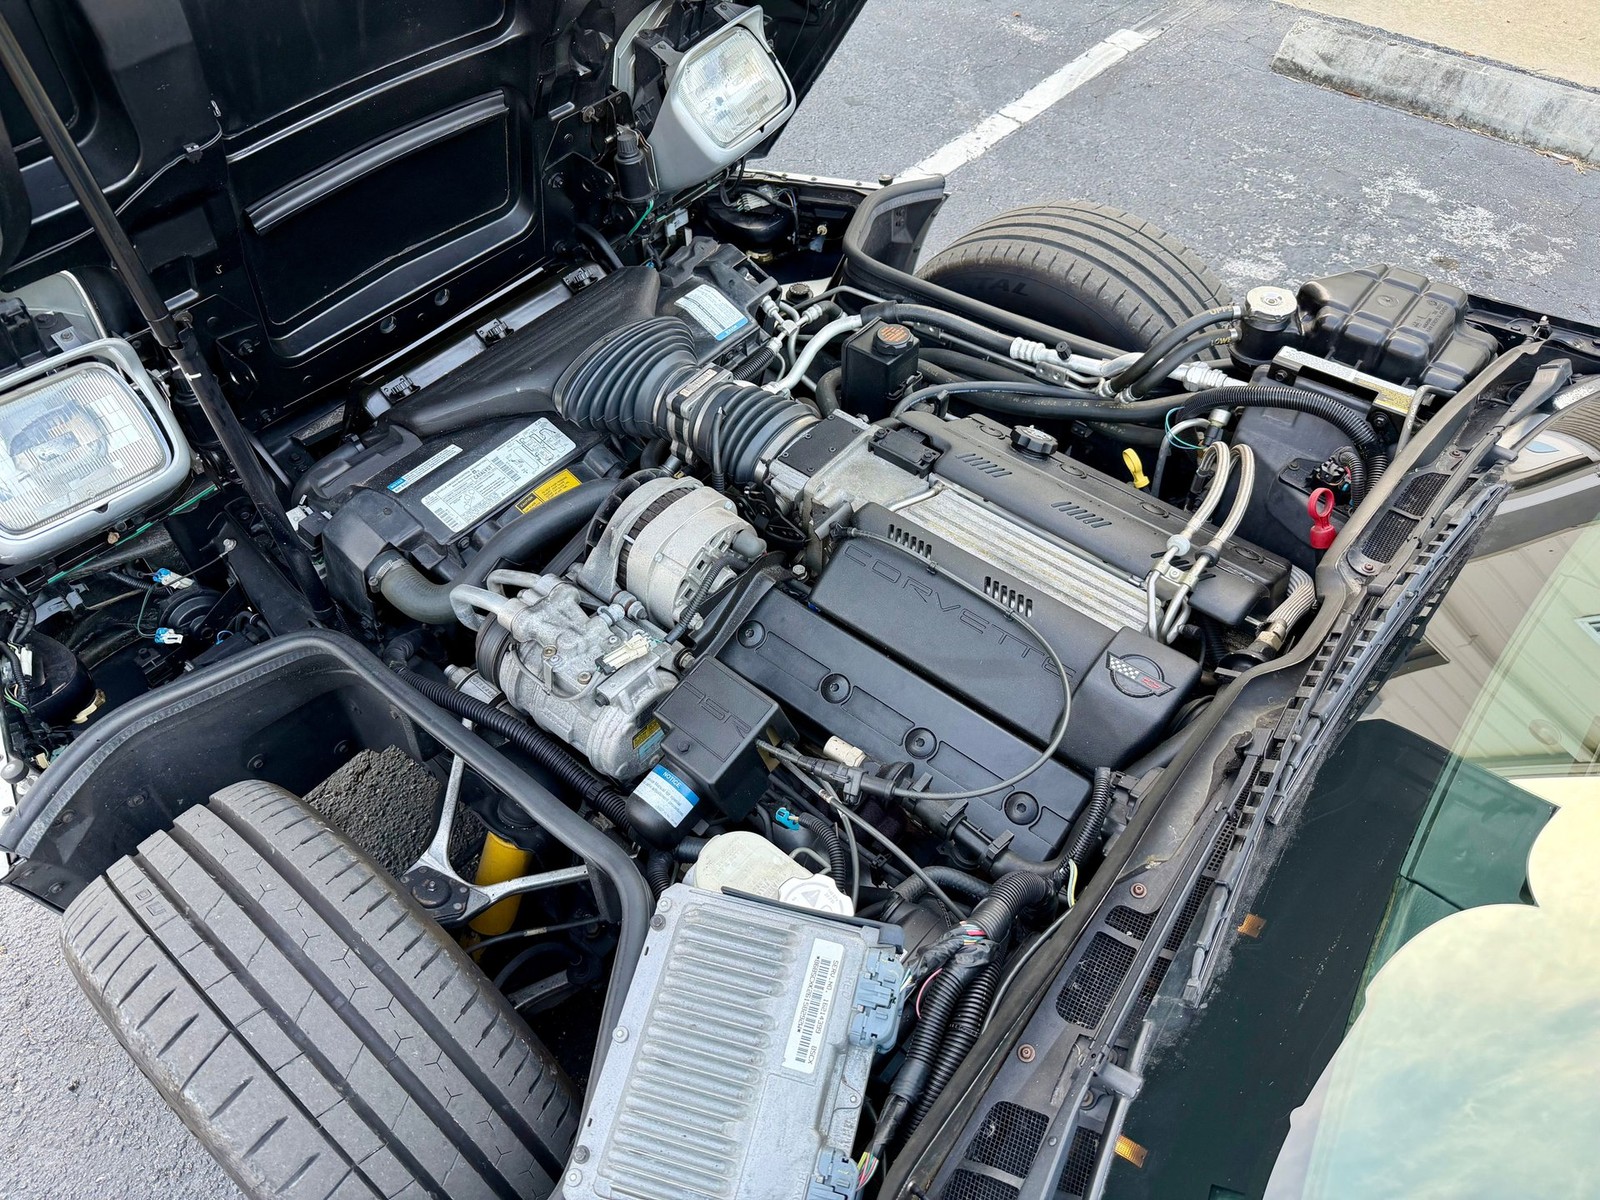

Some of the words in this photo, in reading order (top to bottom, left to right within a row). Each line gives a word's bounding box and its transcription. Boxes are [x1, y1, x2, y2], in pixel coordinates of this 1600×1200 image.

[472, 464, 493, 480] CATALYST
[843, 543, 1077, 679] CORVETTE
[662, 770, 682, 789] NOTICE
[815, 999, 830, 1035] 16214399
